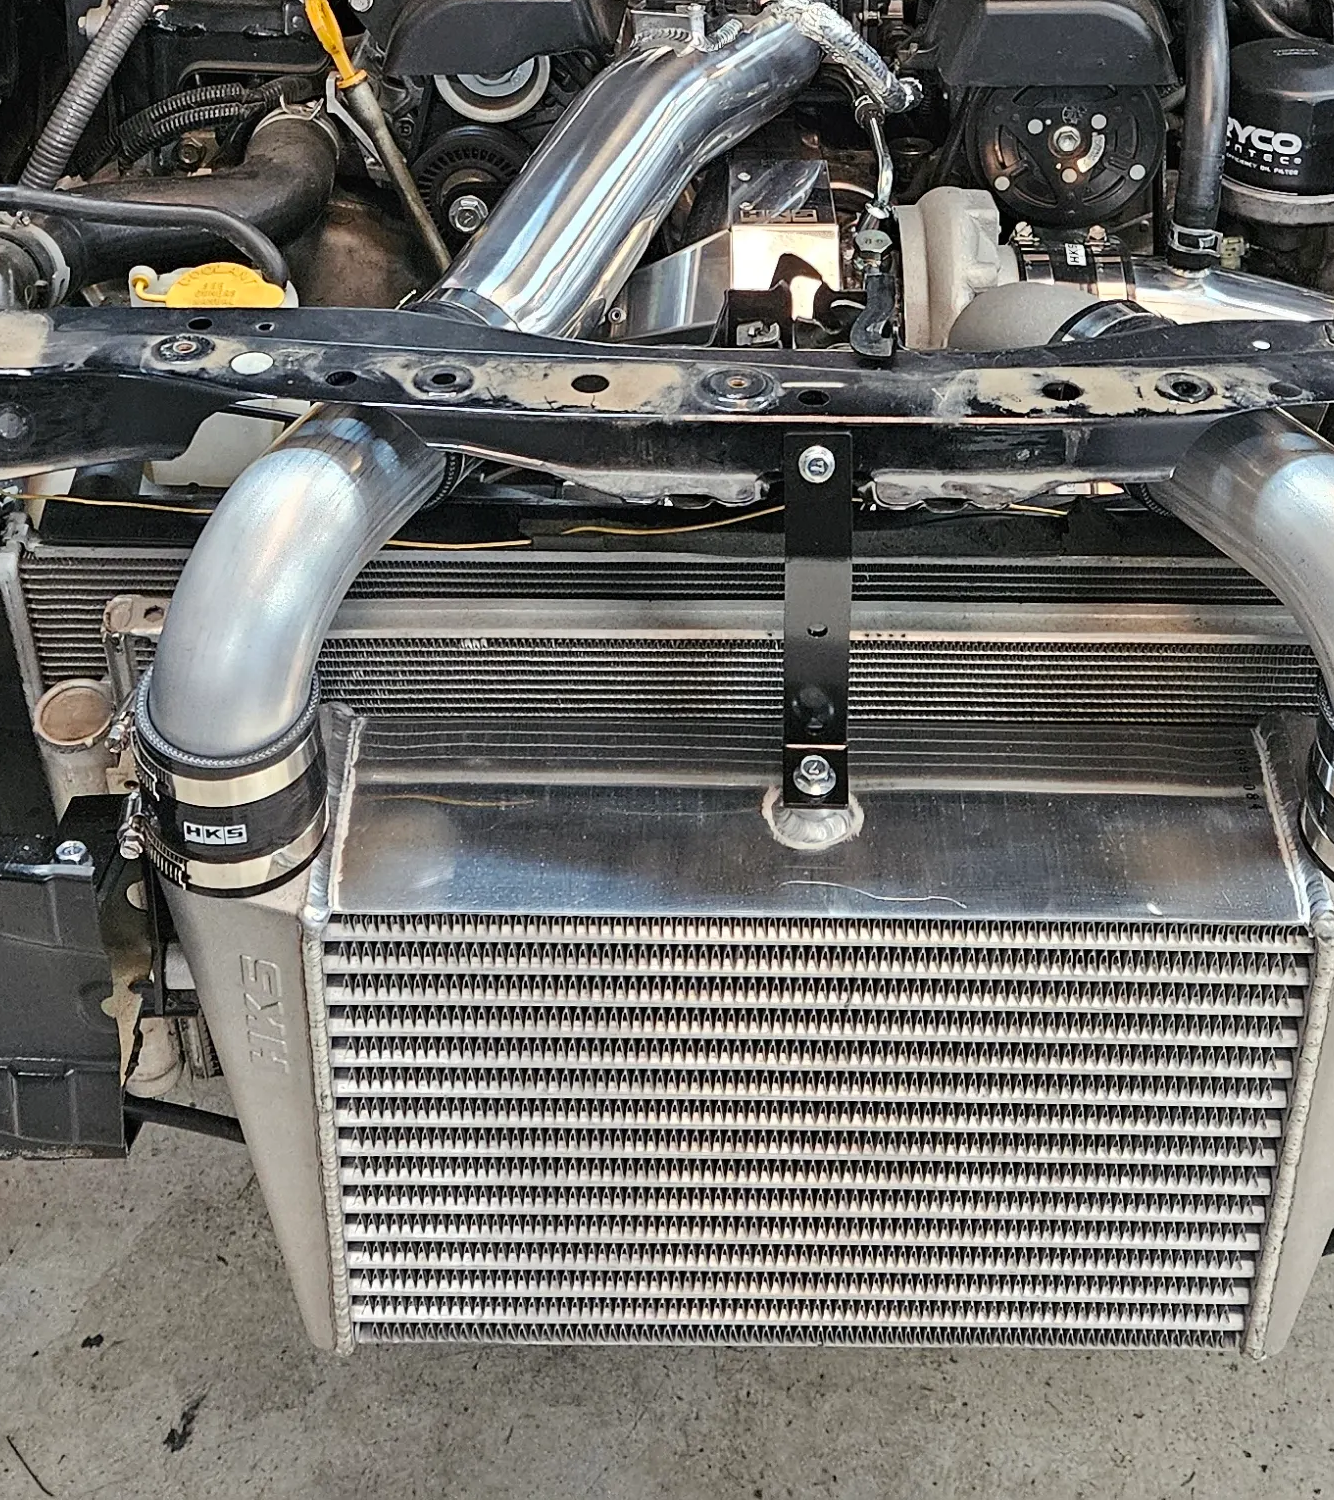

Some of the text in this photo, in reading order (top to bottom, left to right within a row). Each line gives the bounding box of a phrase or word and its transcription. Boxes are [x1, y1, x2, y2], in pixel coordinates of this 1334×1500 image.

[1273, 167, 1300, 176] FILTER
[185, 824, 245, 841] HKS
[239, 954, 290, 1076] HKS
